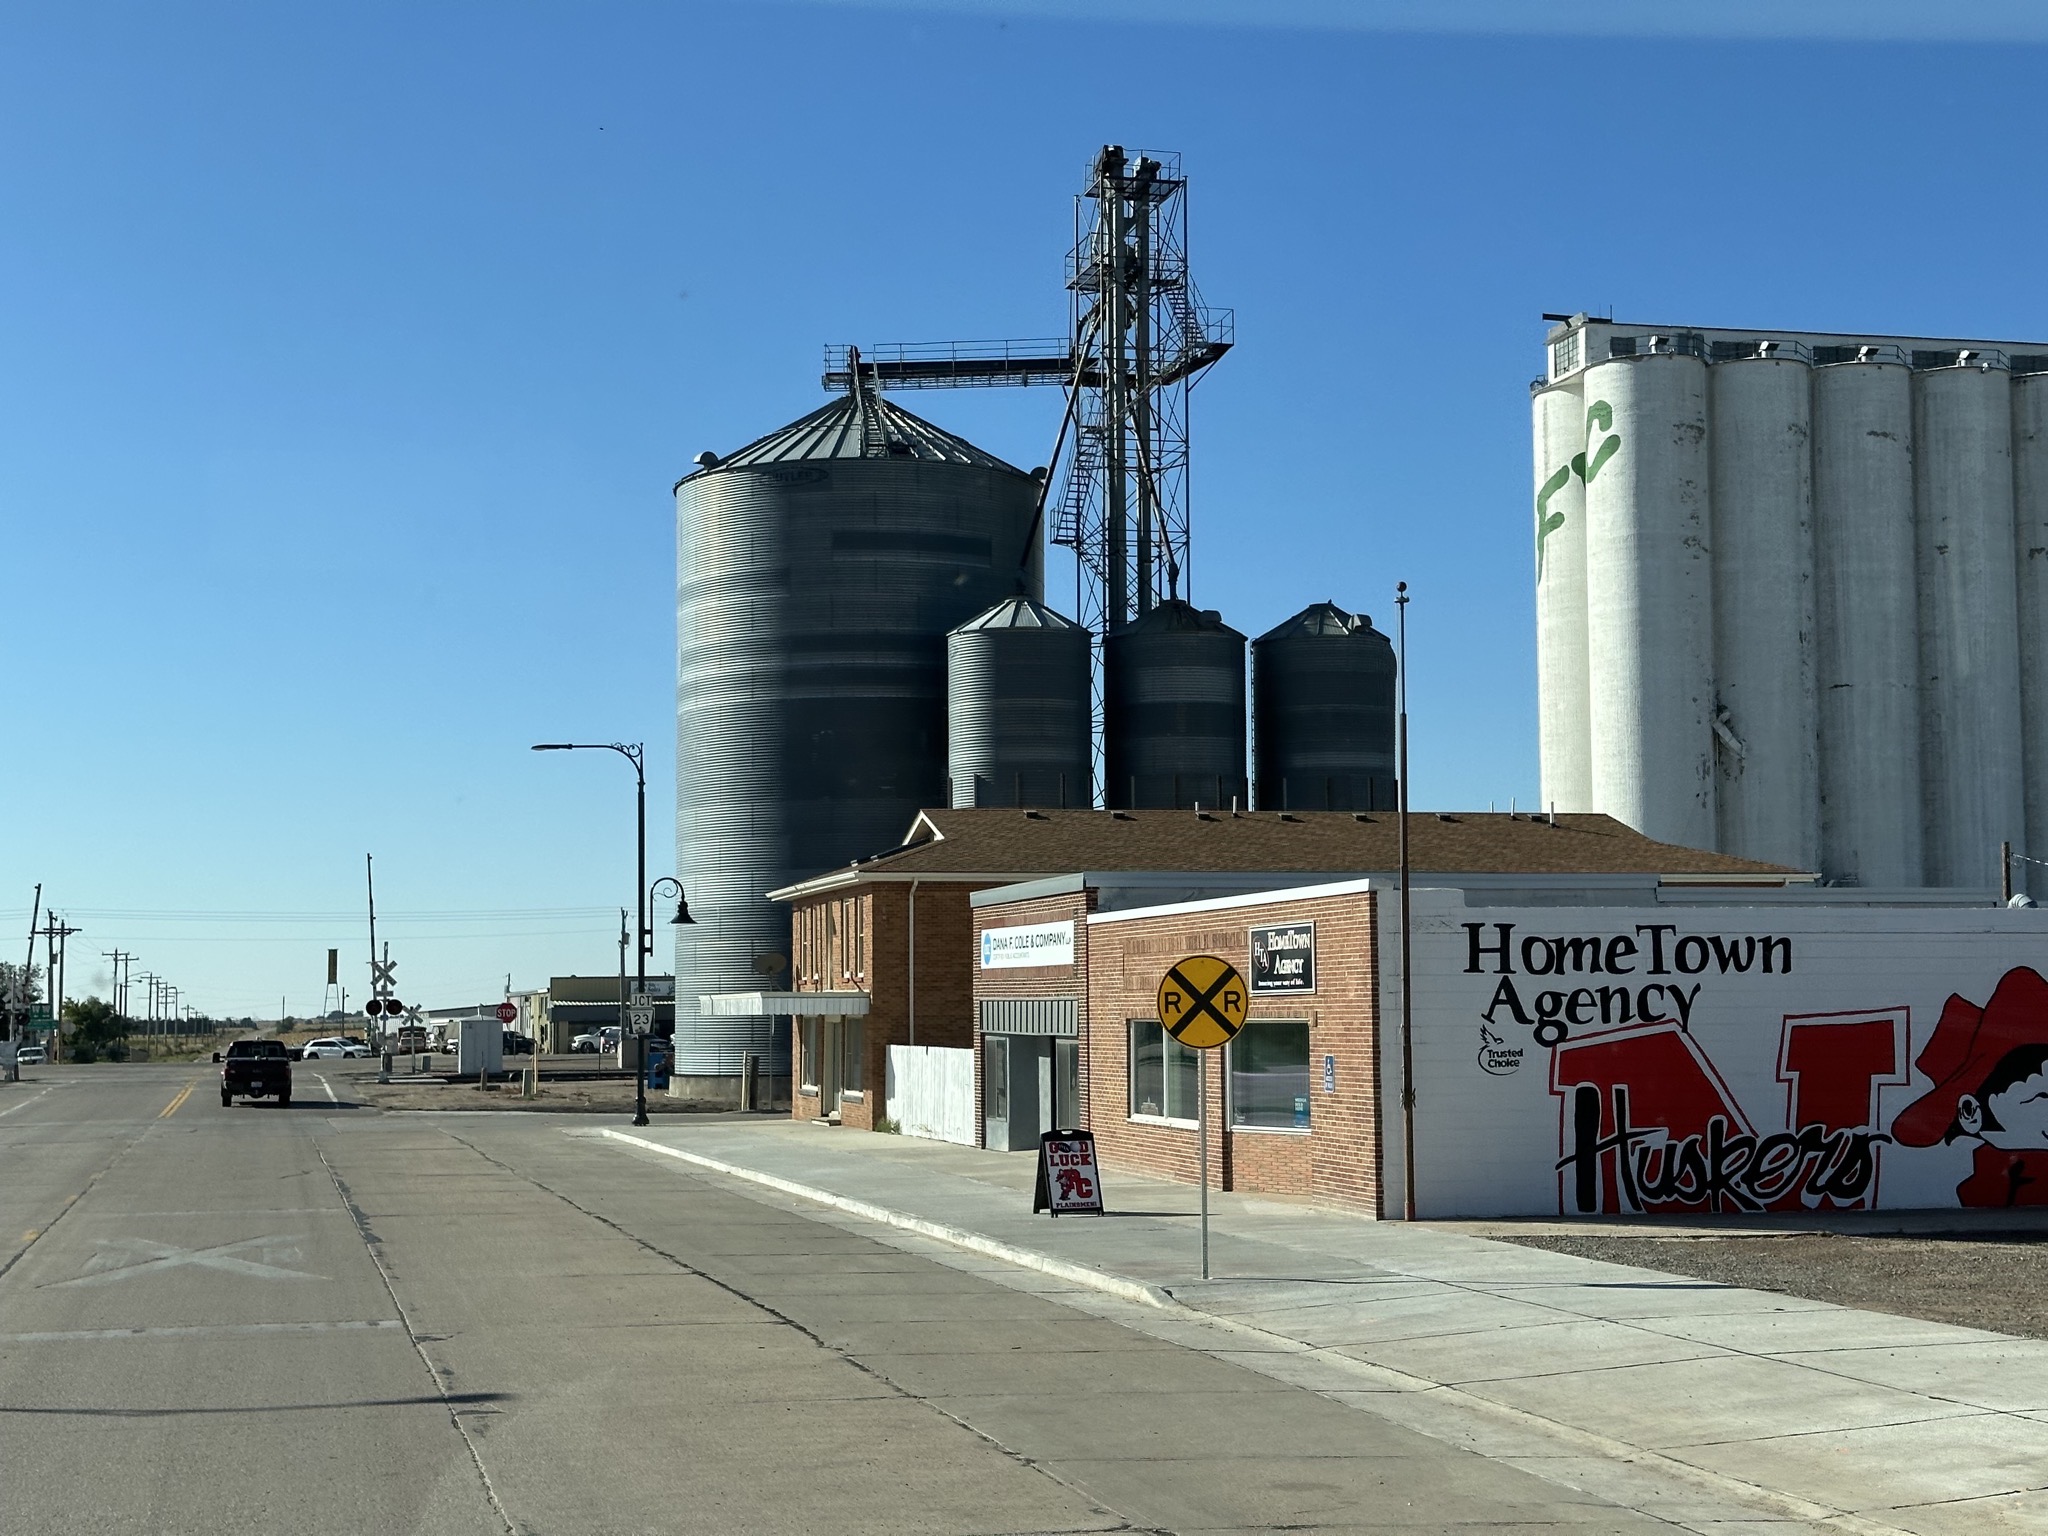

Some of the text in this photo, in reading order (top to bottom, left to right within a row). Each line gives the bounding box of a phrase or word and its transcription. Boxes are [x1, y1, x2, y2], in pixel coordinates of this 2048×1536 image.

[993, 937, 1008, 950] DANA
[1014, 935, 1029, 950] COLE
[1030, 935, 1035, 948] &
[1035, 932, 1066, 947] COMPANY
[1461, 922, 1792, 976] HomeTown
[632, 996, 651, 1006] JCT
[1164, 990, 1241, 1014] R R
[497, 1009, 516, 1017] STOP
[1481, 975, 1702, 1048] Agency
[634, 1014, 649, 1025] 23
[1487, 1048, 1523, 1059] Trusted
[1487, 1058, 1520, 1068] Choice
[1554, 1081, 1892, 1214] Huskers
[1049, 1153, 1092, 1167] LUCK
